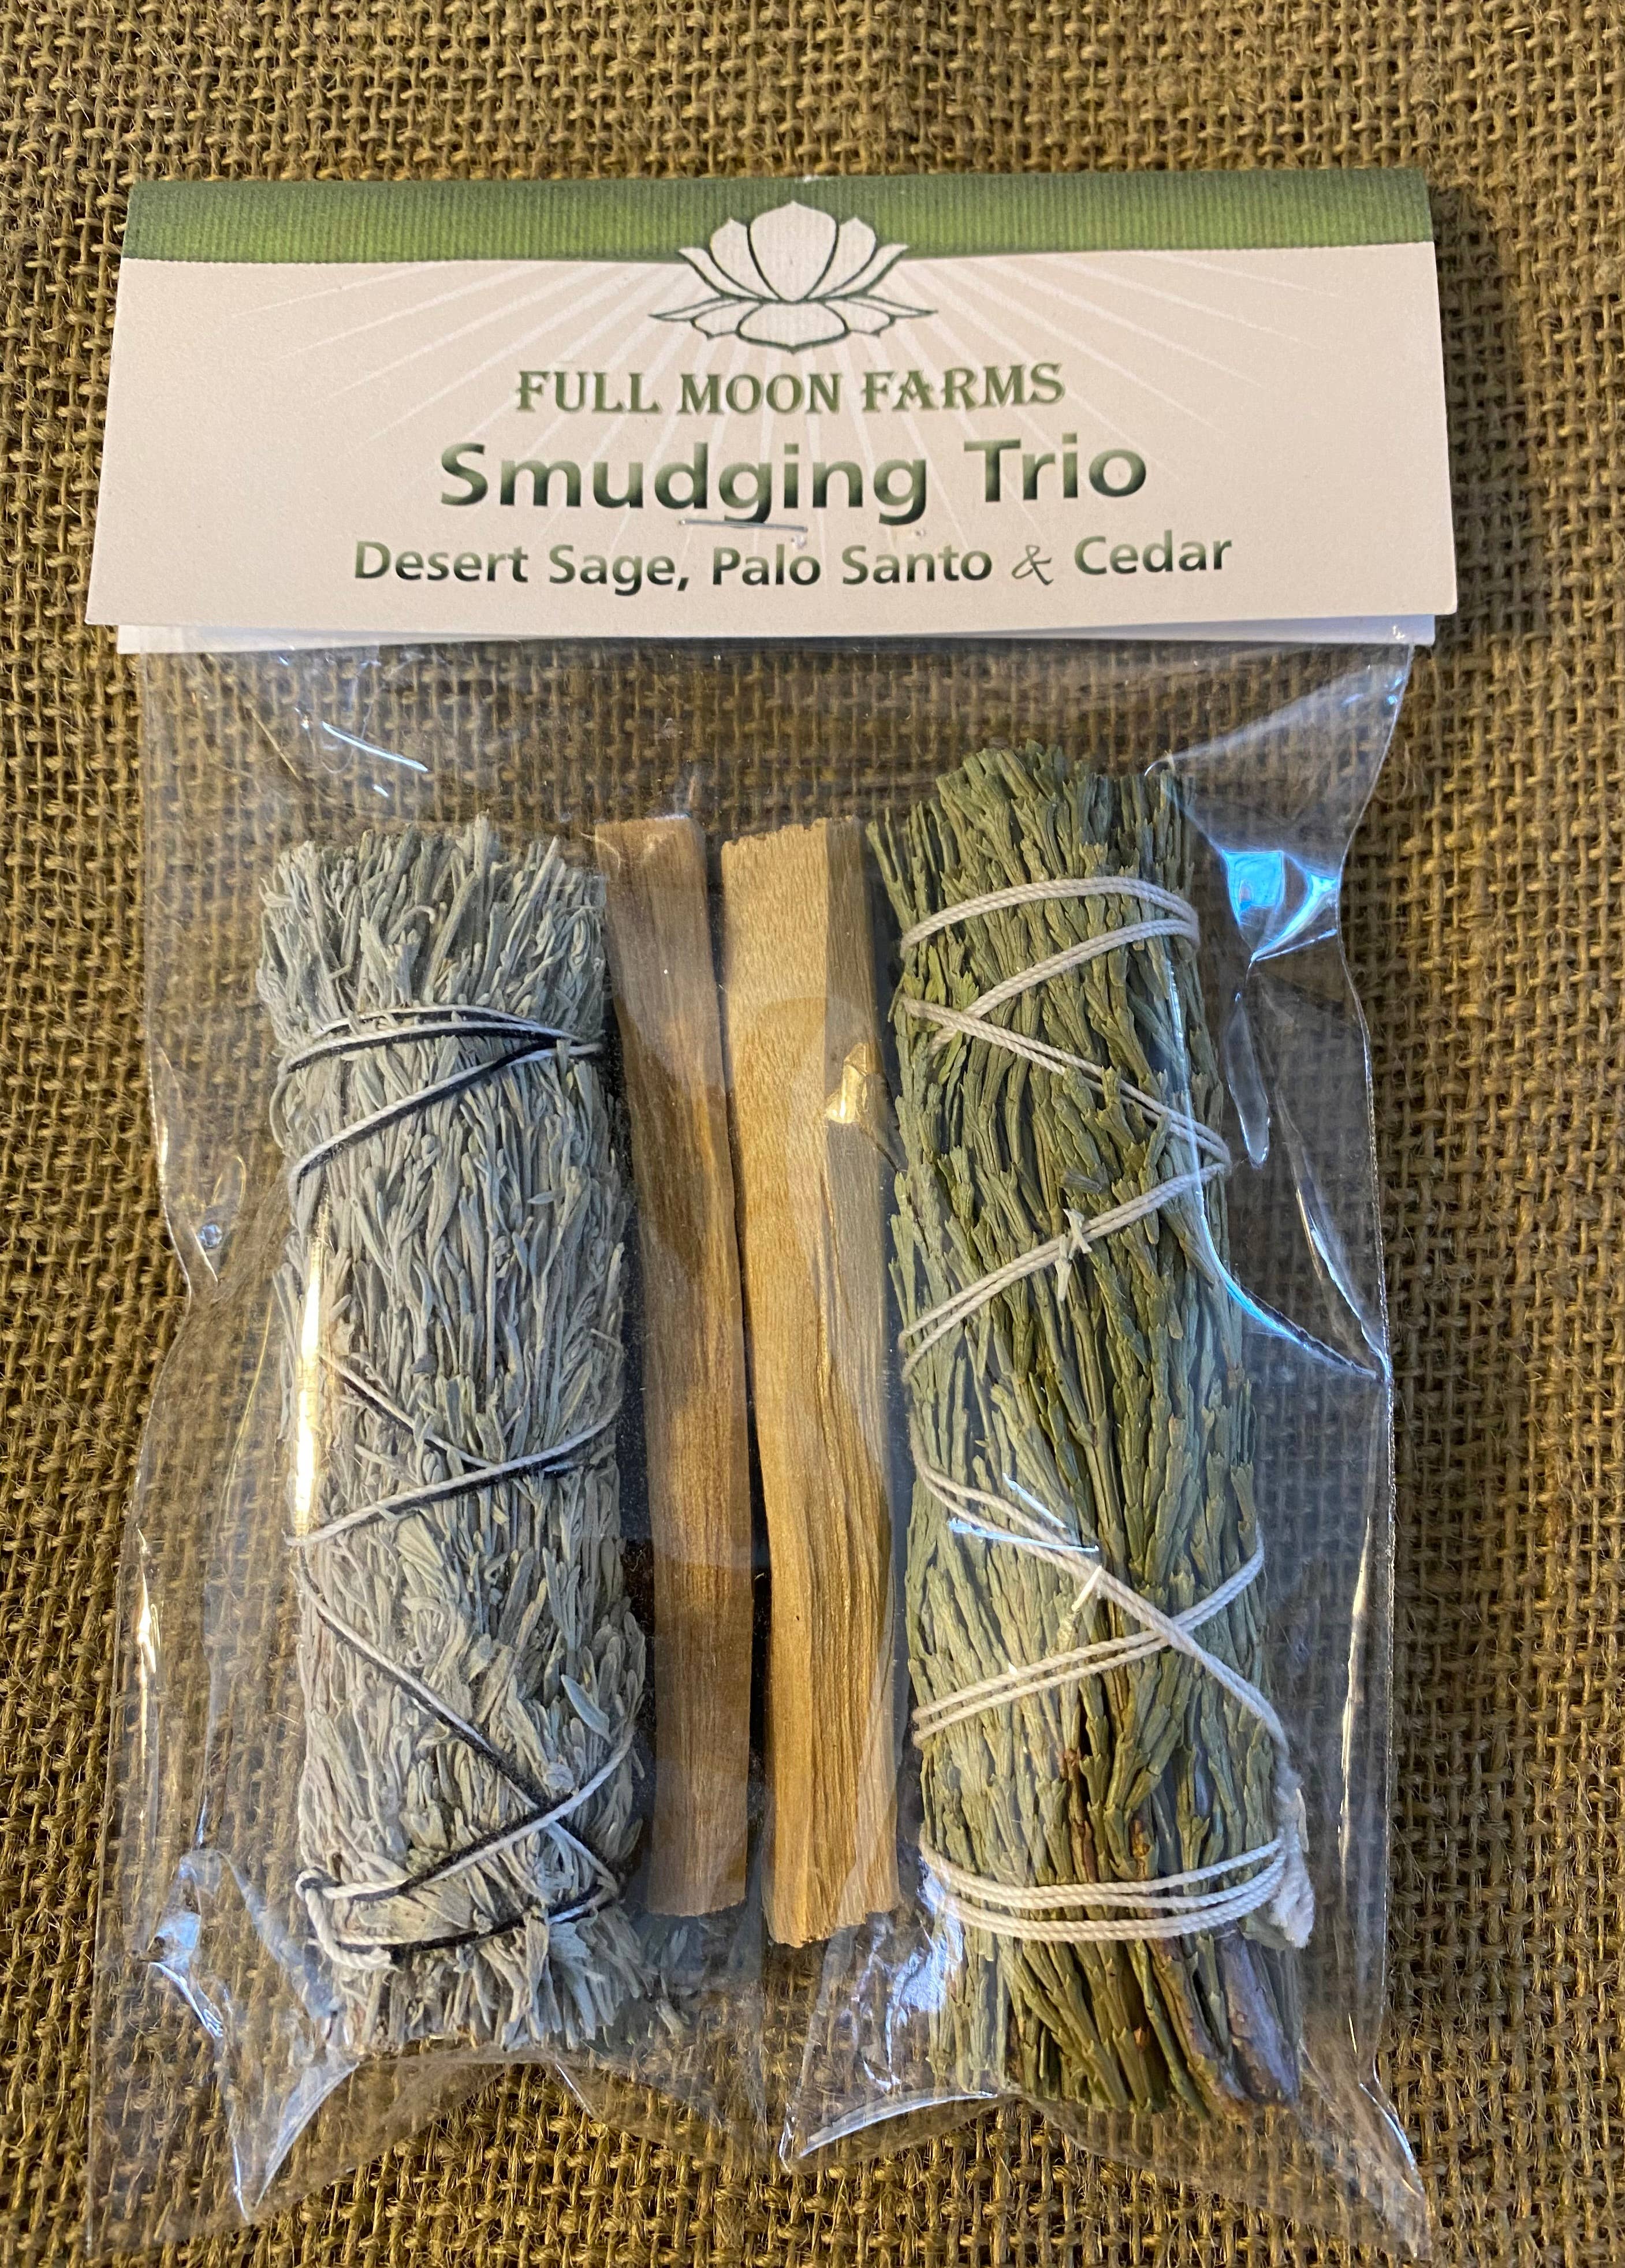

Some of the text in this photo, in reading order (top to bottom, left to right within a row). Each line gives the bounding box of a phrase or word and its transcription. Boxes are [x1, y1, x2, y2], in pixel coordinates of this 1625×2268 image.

[516, 363, 1066, 415] FULL MOON FARMS
[440, 432, 1146, 526] Smudging Trio
[354, 529, 1232, 597] Desert Sage, Palo Santo & Cedar
